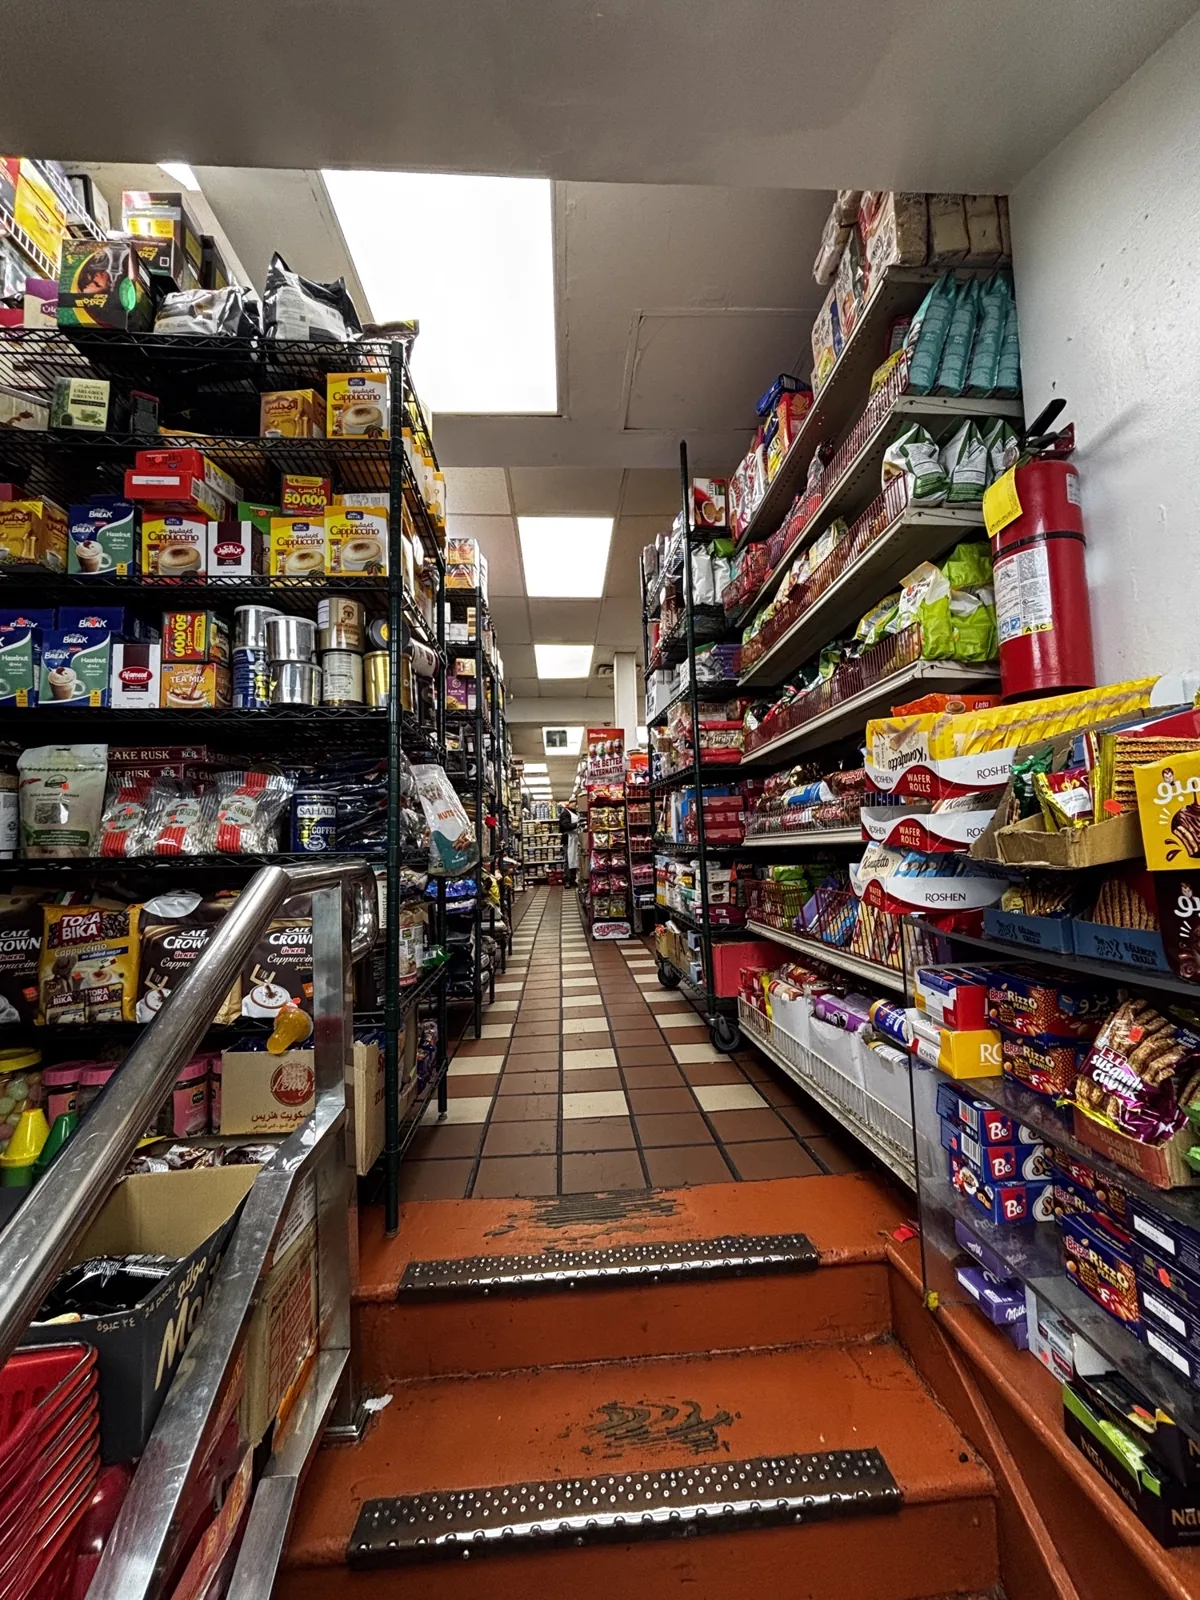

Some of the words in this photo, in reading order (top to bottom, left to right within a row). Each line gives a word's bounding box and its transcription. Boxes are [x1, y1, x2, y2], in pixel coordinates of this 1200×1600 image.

[333, 392, 381, 402] Cappuccino
[284, 494, 327, 506] 50,000
[330, 526, 380, 537] Cappuccino
[148, 531, 199, 544] Cappuccino
[277, 537, 324, 548] Cappuccino
[63, 636, 89, 644] BREAK
[174, 614, 187, 657] 50,000
[44, 652, 70, 660] BREAK
[170, 676, 187, 684] TEA
[189, 676, 205, 684] MIX
[107, 751, 138, 760] CAKE
[140, 750, 170, 760] RUSK
[590, 760, 601, 768] THE
[602, 756, 622, 767] BETTER
[590, 766, 623, 777] ALTERNATIVE
[874, 774, 894, 784] ROSHEN
[907, 773, 932, 784] WAFER
[909, 784, 931, 793] ROLLS
[299, 808, 335, 816] SAHADI
[312, 826, 336, 834] COFFEE
[868, 825, 887, 834] ROSHEN
[899, 826, 921, 837] WAFER
[900, 836, 920, 846] ROLLS
[862, 854, 890, 872] Konafetto
[868, 885, 882, 897] WAFER
[870, 894, 882, 906] ROLLS
[925, 892, 966, 903] ROSHEN
[62, 912, 101, 928] TORA
[1, 929, 30, 938] CAFÉ
[62, 924, 98, 940] BIKA
[54, 943, 108, 959] Cappuccino
[174, 950, 199, 959] ÜLKER
[281, 946, 306, 955] ÜLKER
[88, 988, 108, 997] TORA
[53, 996, 72, 1004] BIKA
[90, 995, 108, 1004] BIKA
[1012, 1002, 1036, 1015] PEANUTS
[1028, 1058, 1053, 1072] PEANUTS
[988, 1122, 1009, 1140] Be
[992, 1158, 1012, 1176] Be
[1005, 1200, 1023, 1218] Be
[1098, 1268, 1128, 1295] PEANUTS
[156, 1281, 176, 1308] packs
